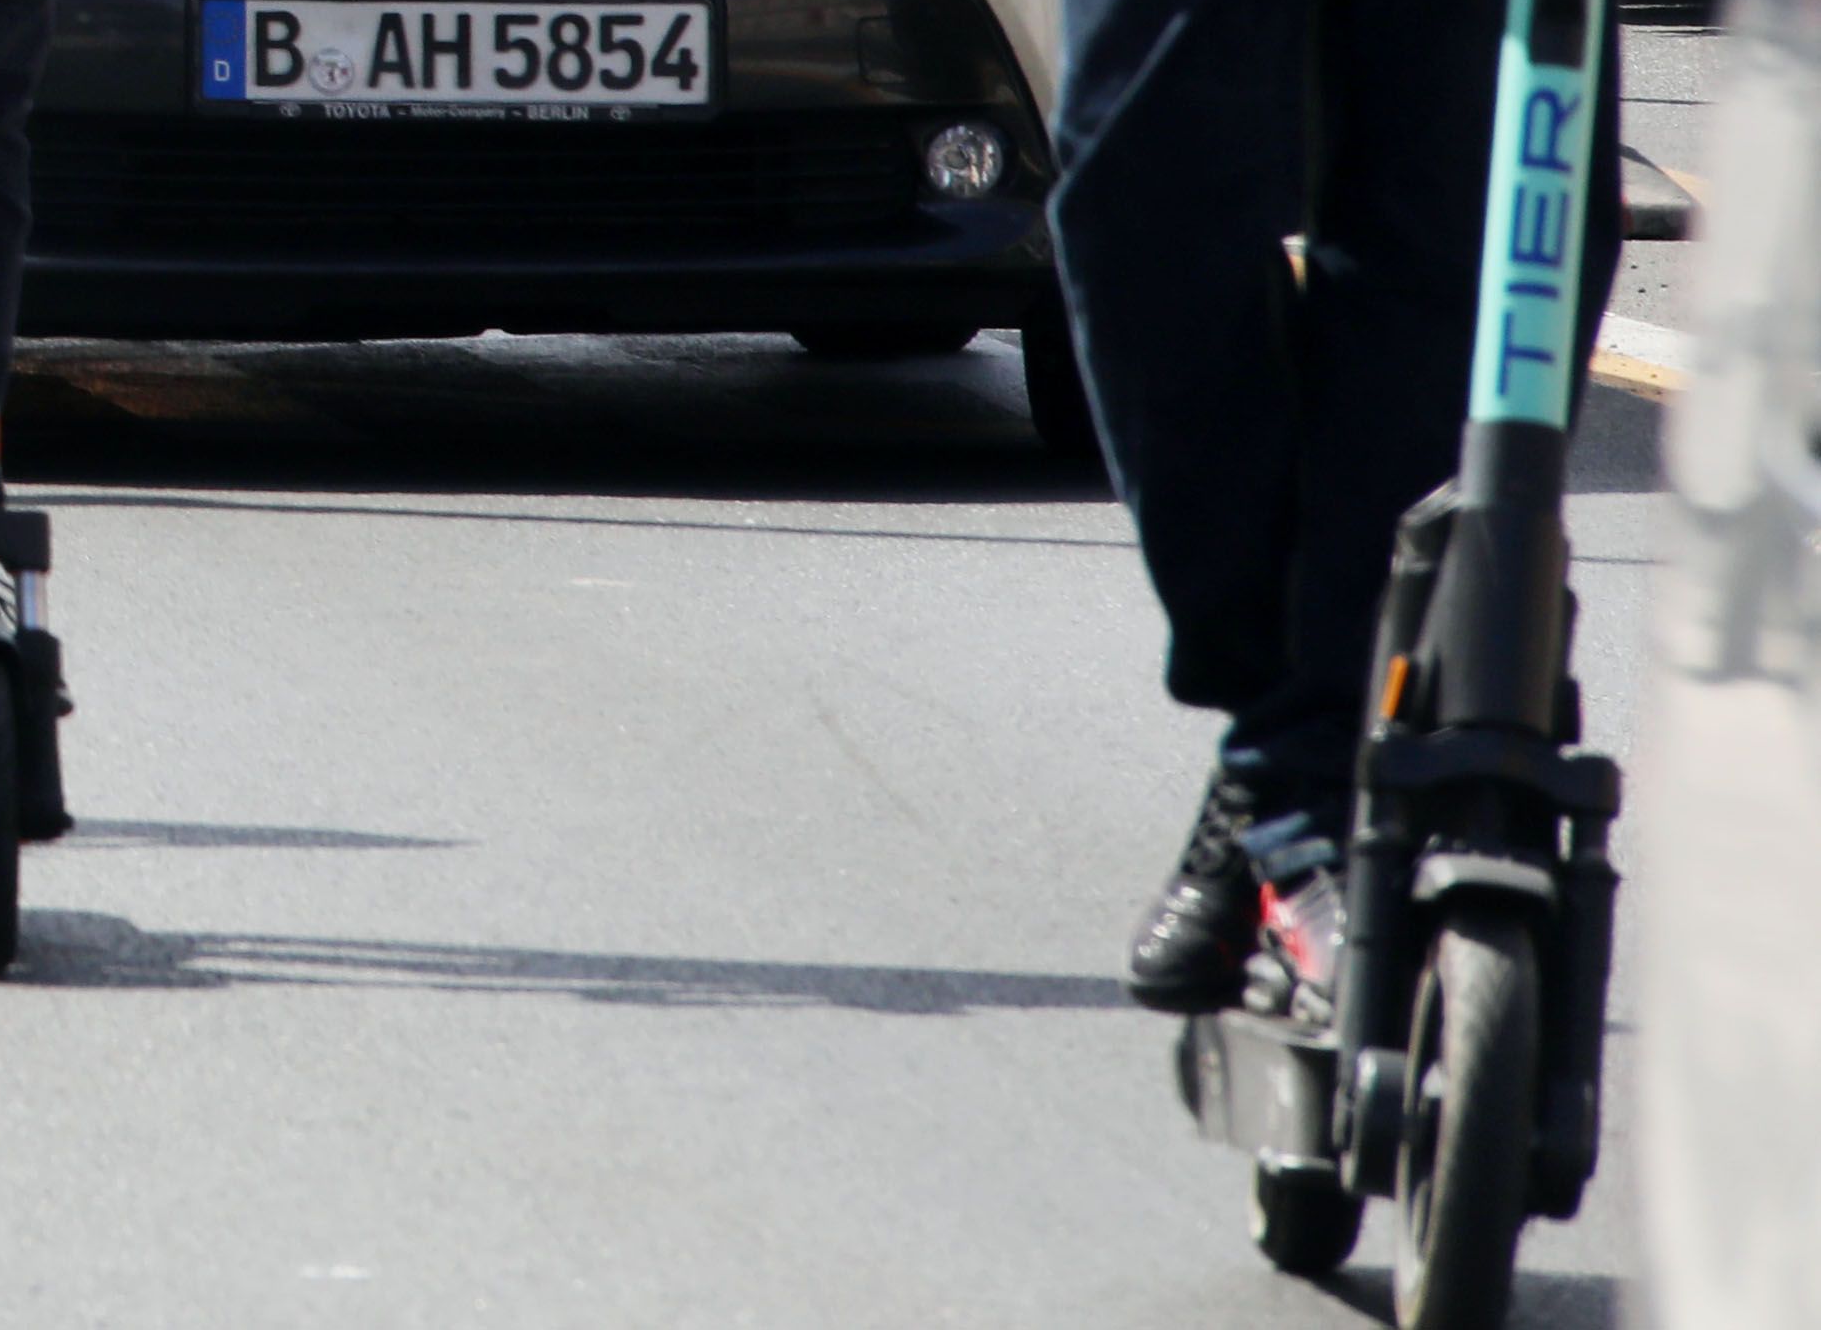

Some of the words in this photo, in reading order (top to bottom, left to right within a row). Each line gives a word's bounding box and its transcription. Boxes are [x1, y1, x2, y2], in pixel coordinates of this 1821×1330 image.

[214, 60, 230, 82] D
[255, 10, 304, 87] B
[368, 12, 471, 90] AH
[493, 13, 699, 92] 5854
[323, 104, 392, 119] TOYOTA
[527, 105, 590, 120] BERLIN
[1495, 84, 1582, 396] TIER
